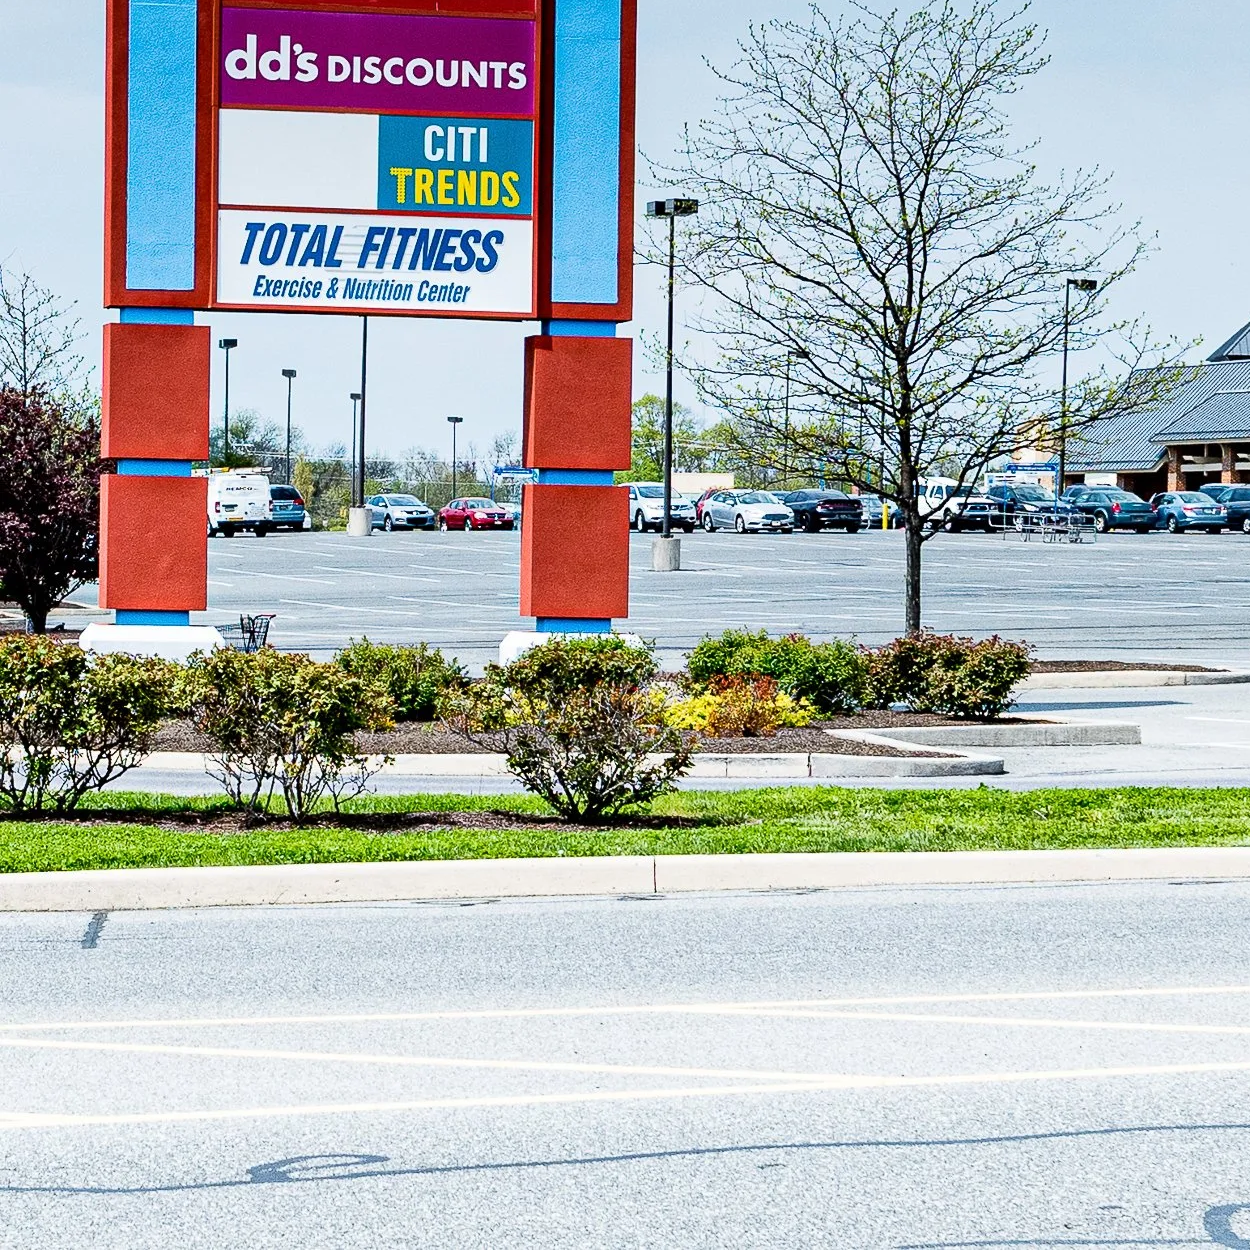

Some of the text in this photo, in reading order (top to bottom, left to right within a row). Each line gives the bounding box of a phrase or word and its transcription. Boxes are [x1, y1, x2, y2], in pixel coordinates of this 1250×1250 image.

[224, 34, 527, 90] dd's DISCOUNTS
[424, 124, 488, 163] CITI
[390, 167, 520, 208] TRENDS
[239, 222, 504, 274] TOTAL FITNESS
[252, 274, 471, 303] Exercise & Nutrition Center
